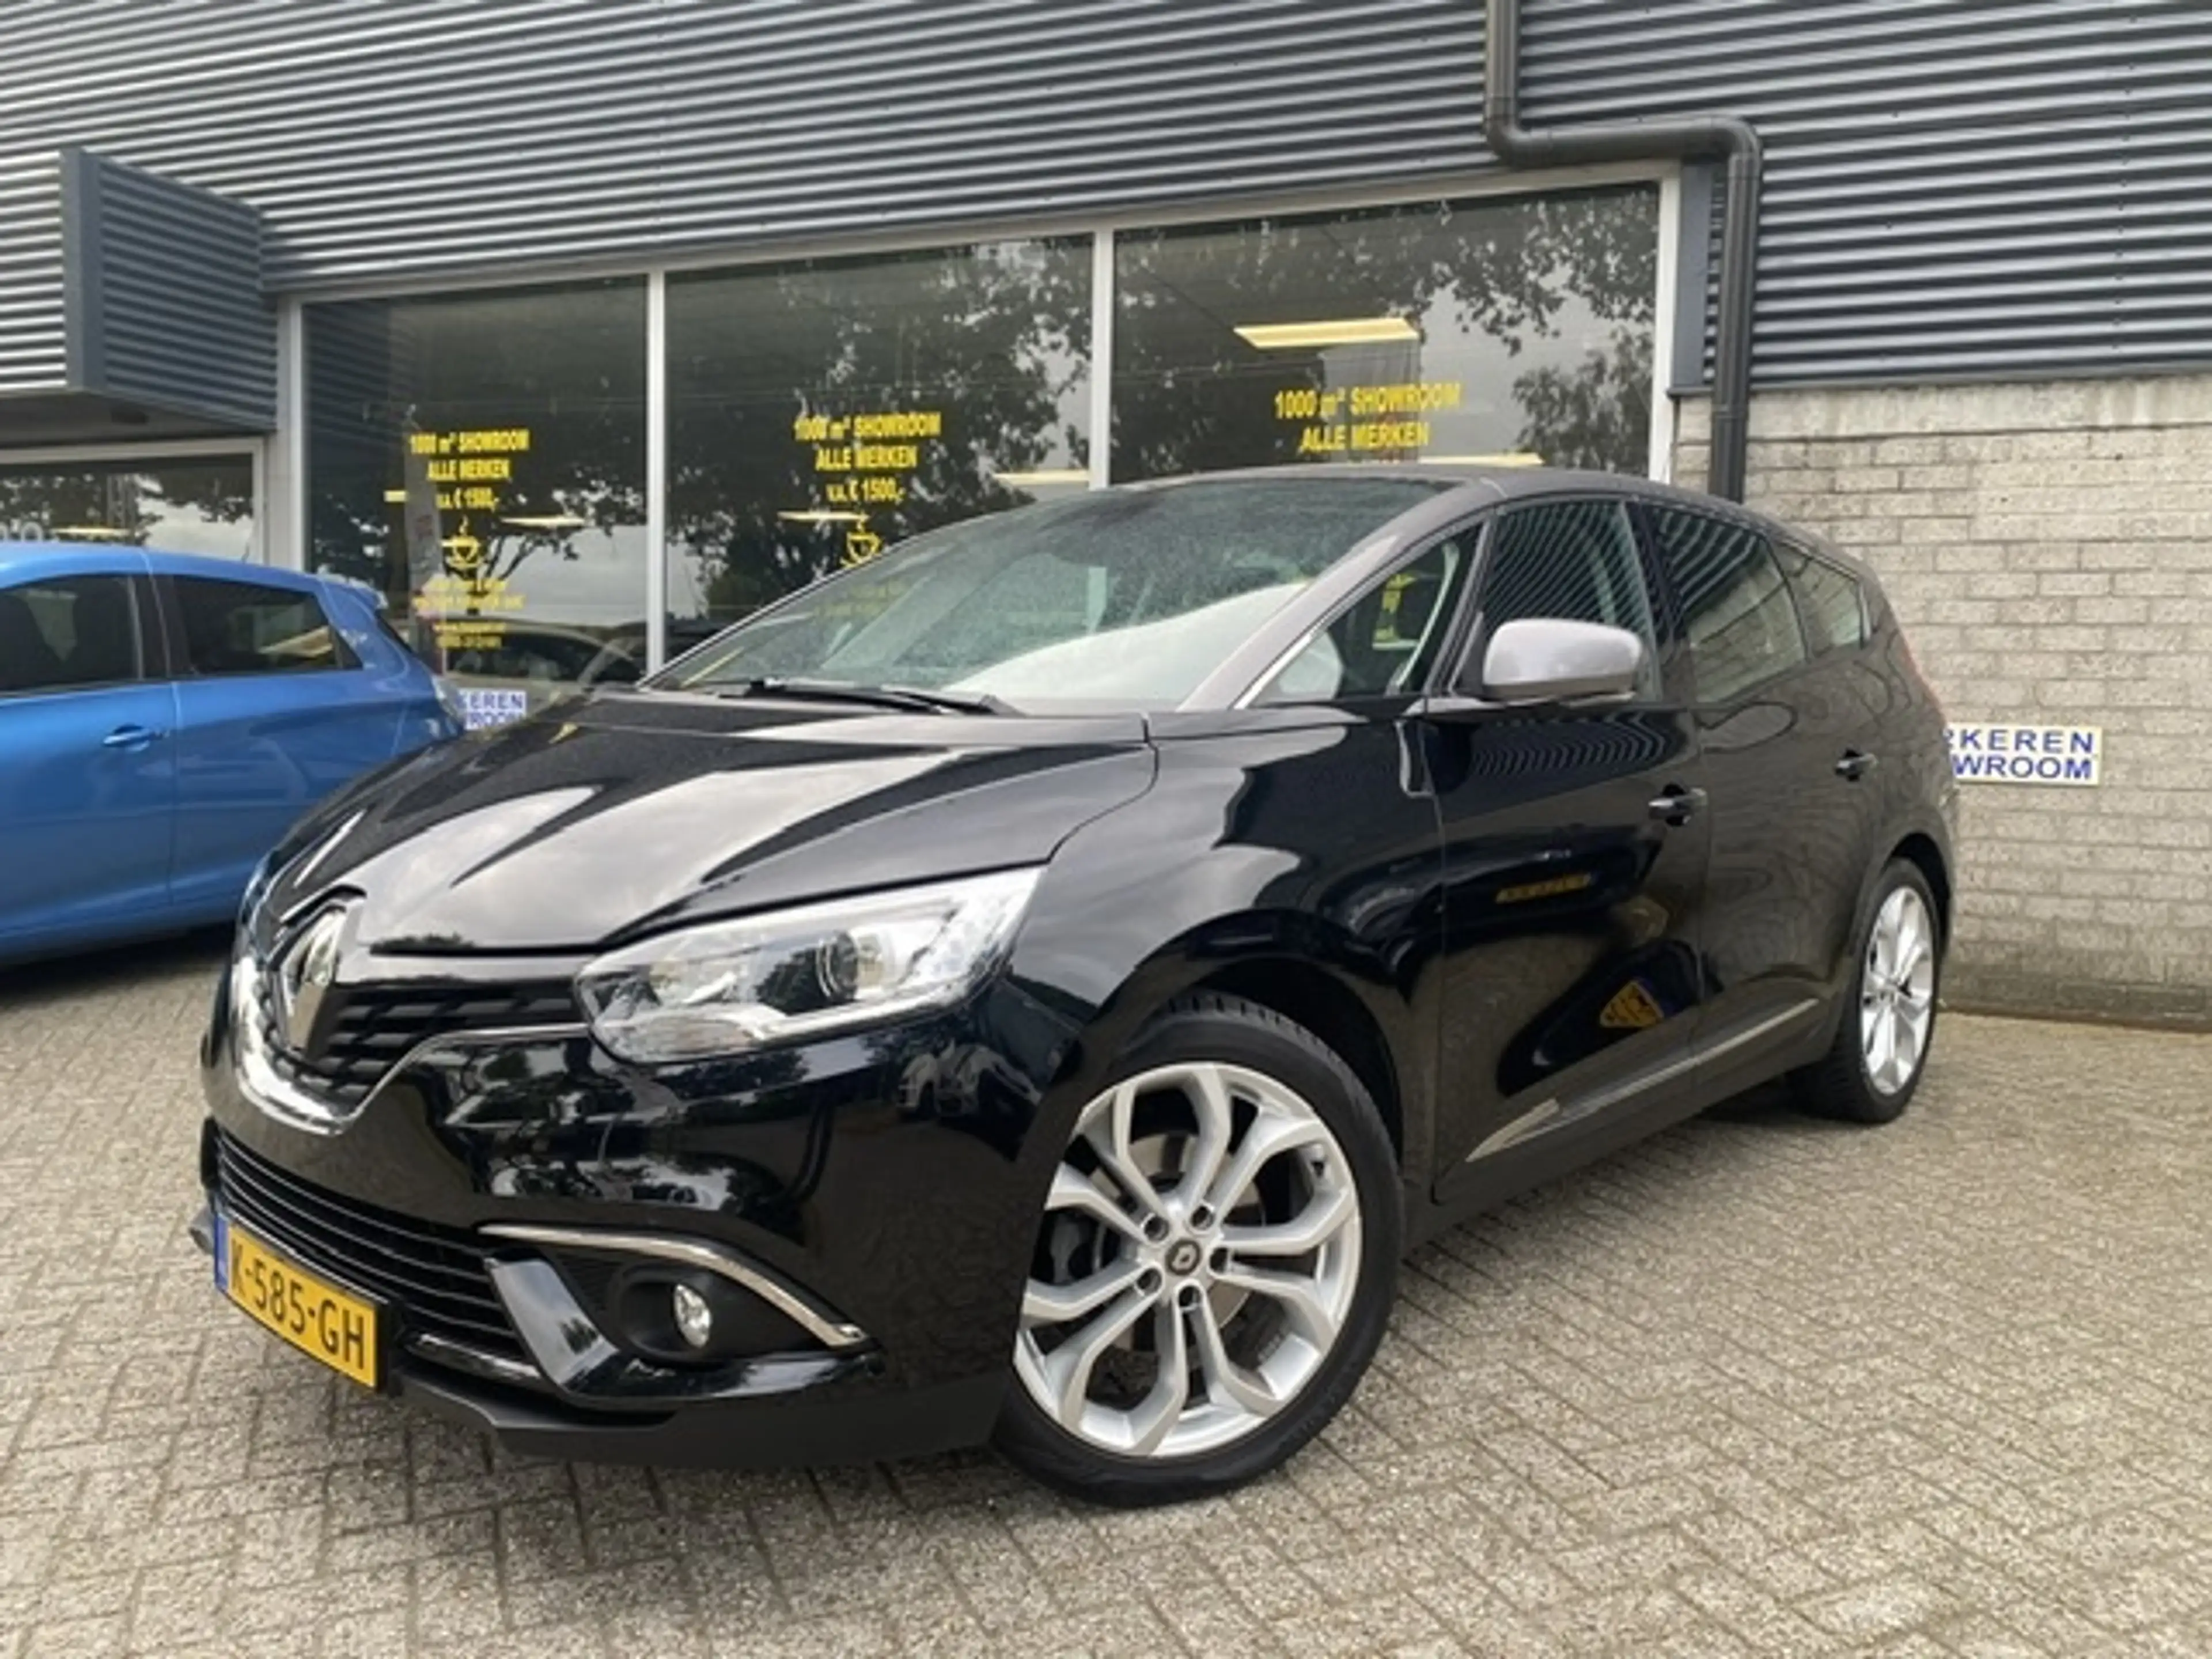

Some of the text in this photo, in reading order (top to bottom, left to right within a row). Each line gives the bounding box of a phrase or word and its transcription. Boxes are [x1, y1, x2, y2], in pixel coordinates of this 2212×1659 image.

[1275, 390, 1317, 419] 1000
[1349, 382, 1461, 416] SHOWROOM
[854, 411, 941, 437] SHOWROOM
[1299, 421, 1430, 452] ALLE MERKEN
[459, 428, 529, 453] SHOWROOM
[427, 457, 510, 481] ALLE MERKEN
[815, 445, 917, 471] ALLE MERKEN
[1951, 754, 2092, 779] WROOM
[230, 1237, 365, 1370] K-585-GH
